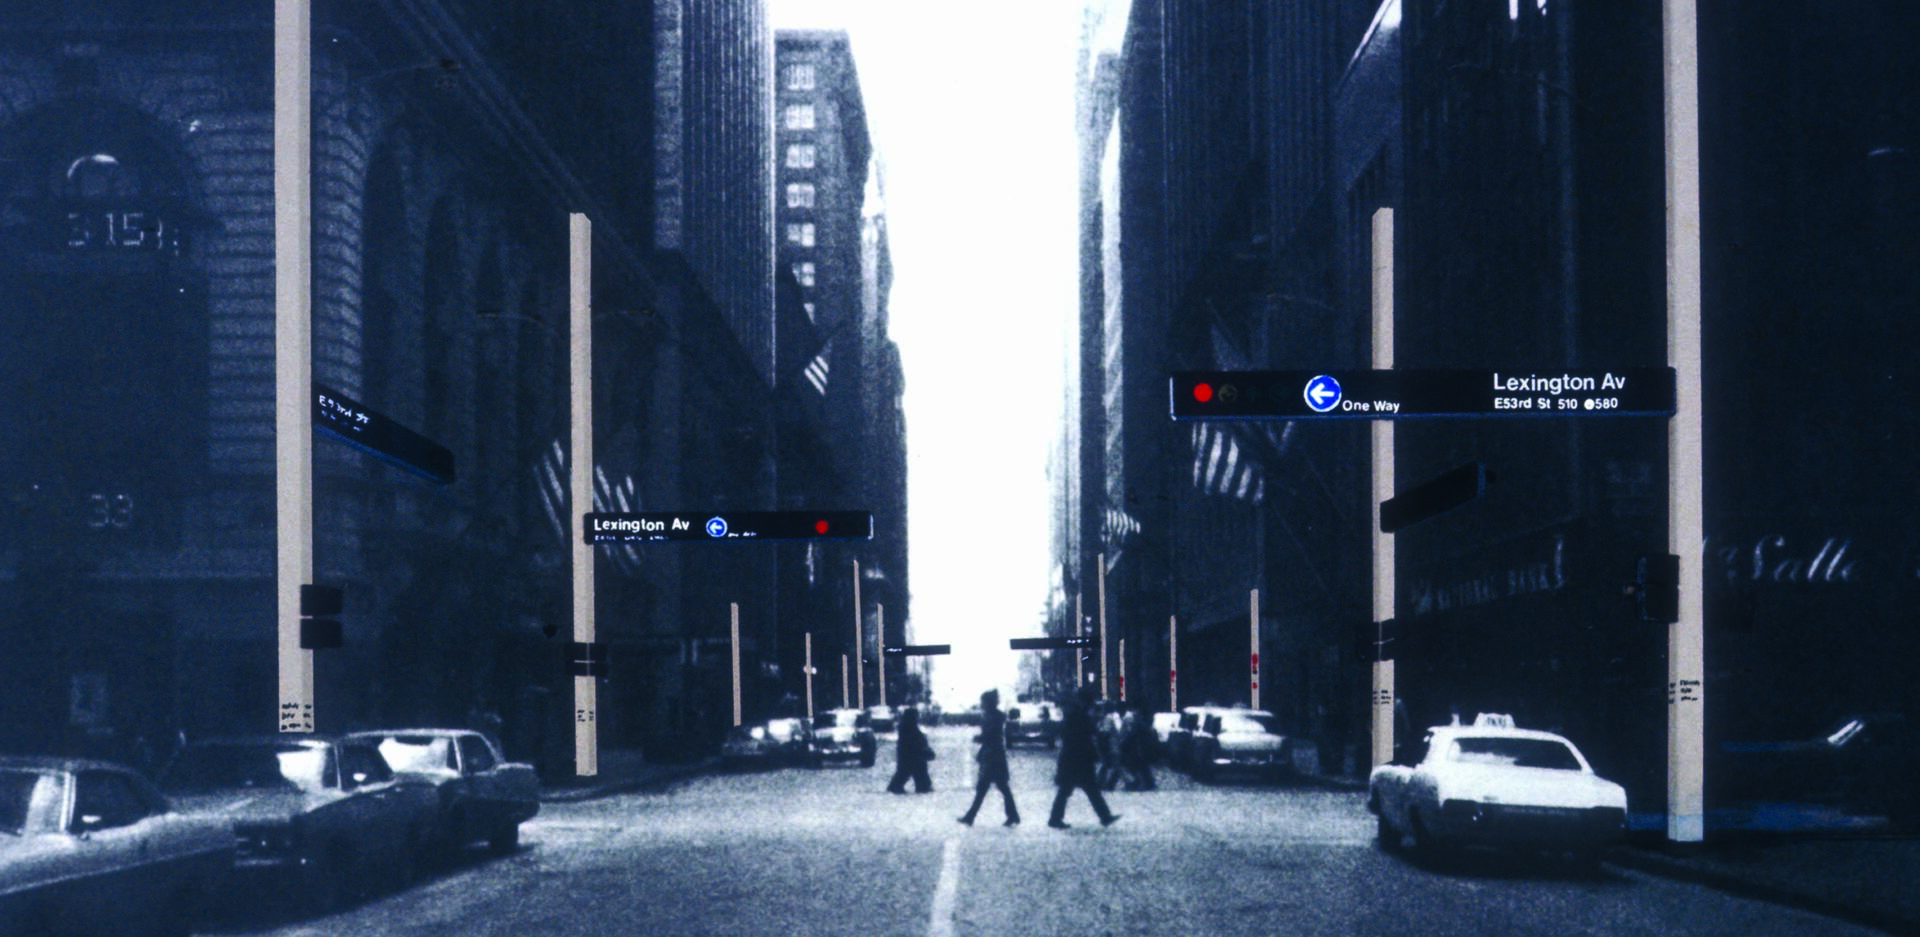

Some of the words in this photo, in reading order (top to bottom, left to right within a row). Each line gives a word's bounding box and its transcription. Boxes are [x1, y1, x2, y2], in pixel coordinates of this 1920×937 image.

[1494, 373, 1595, 395] Lexington
[1601, 373, 1626, 390] Av
[1342, 400, 1370, 411] One
[1374, 401, 1400, 413] Way
[1494, 397, 1532, 410] E53rd
[1537, 398, 1551, 410] St
[1558, 398, 1578, 410] 510
[593, 517, 665, 533] Lexington
[671, 517, 690, 531] Av
[1752, 534, 1857, 582] Salle
